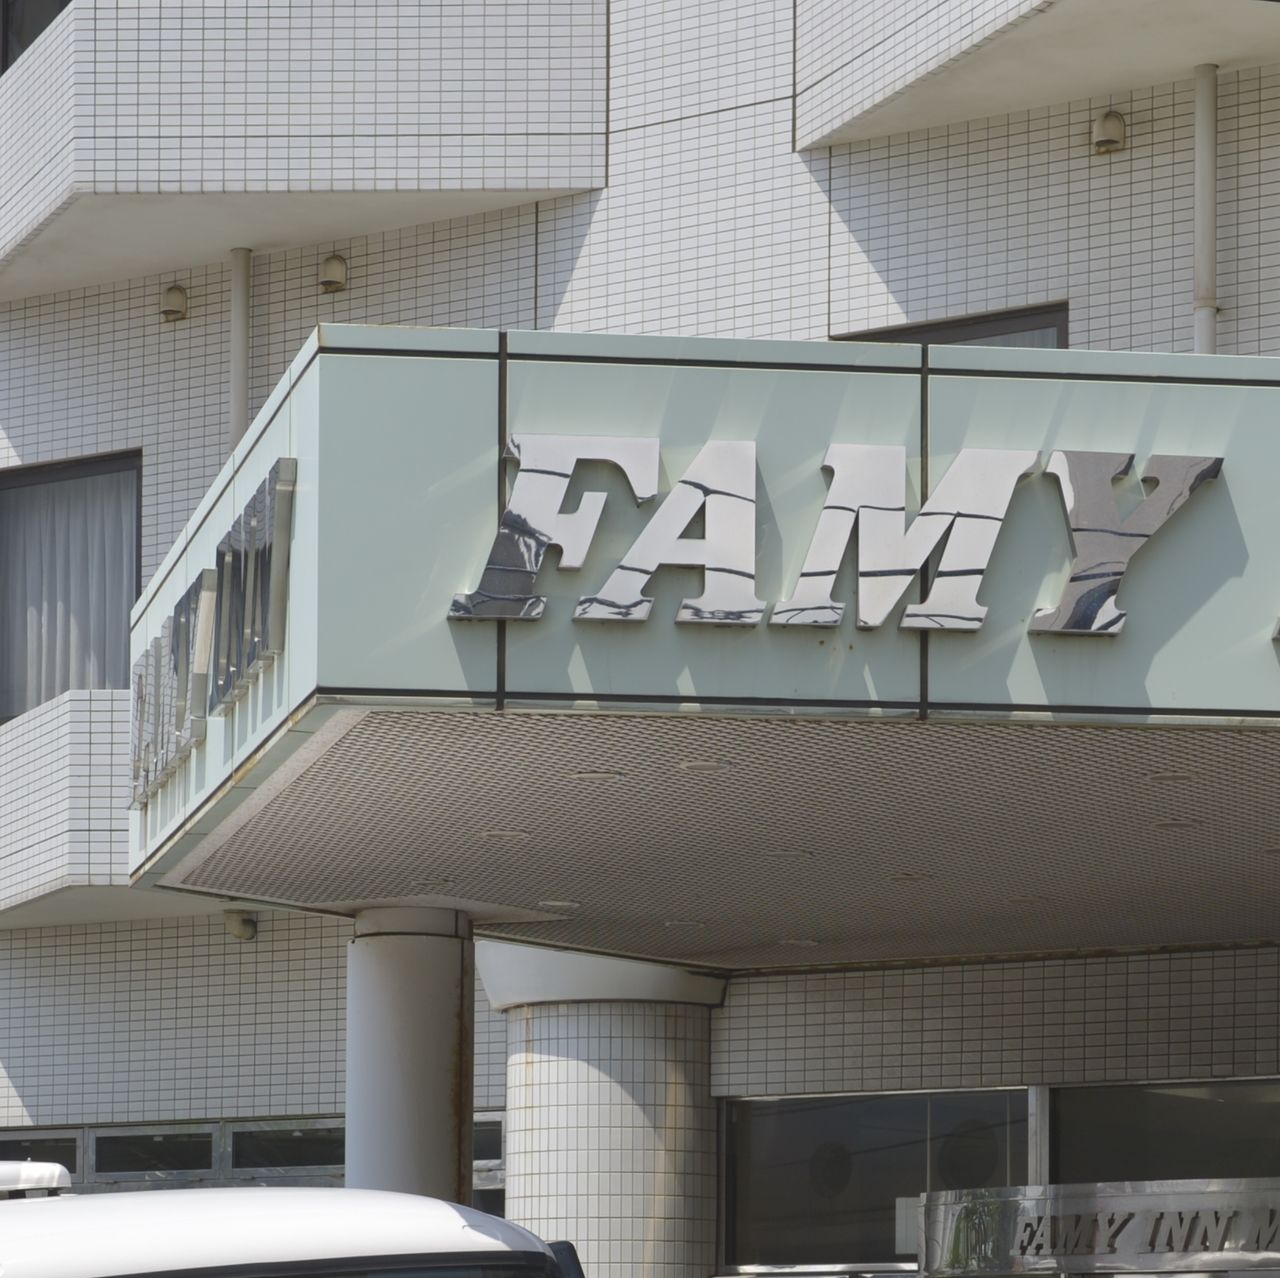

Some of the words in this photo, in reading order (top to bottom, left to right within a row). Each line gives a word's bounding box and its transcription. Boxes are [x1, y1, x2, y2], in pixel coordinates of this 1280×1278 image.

[448, 433, 1224, 637] FAMY
[1010, 1212, 1135, 1256] FAMY
[1137, 1209, 1240, 1255] INN
